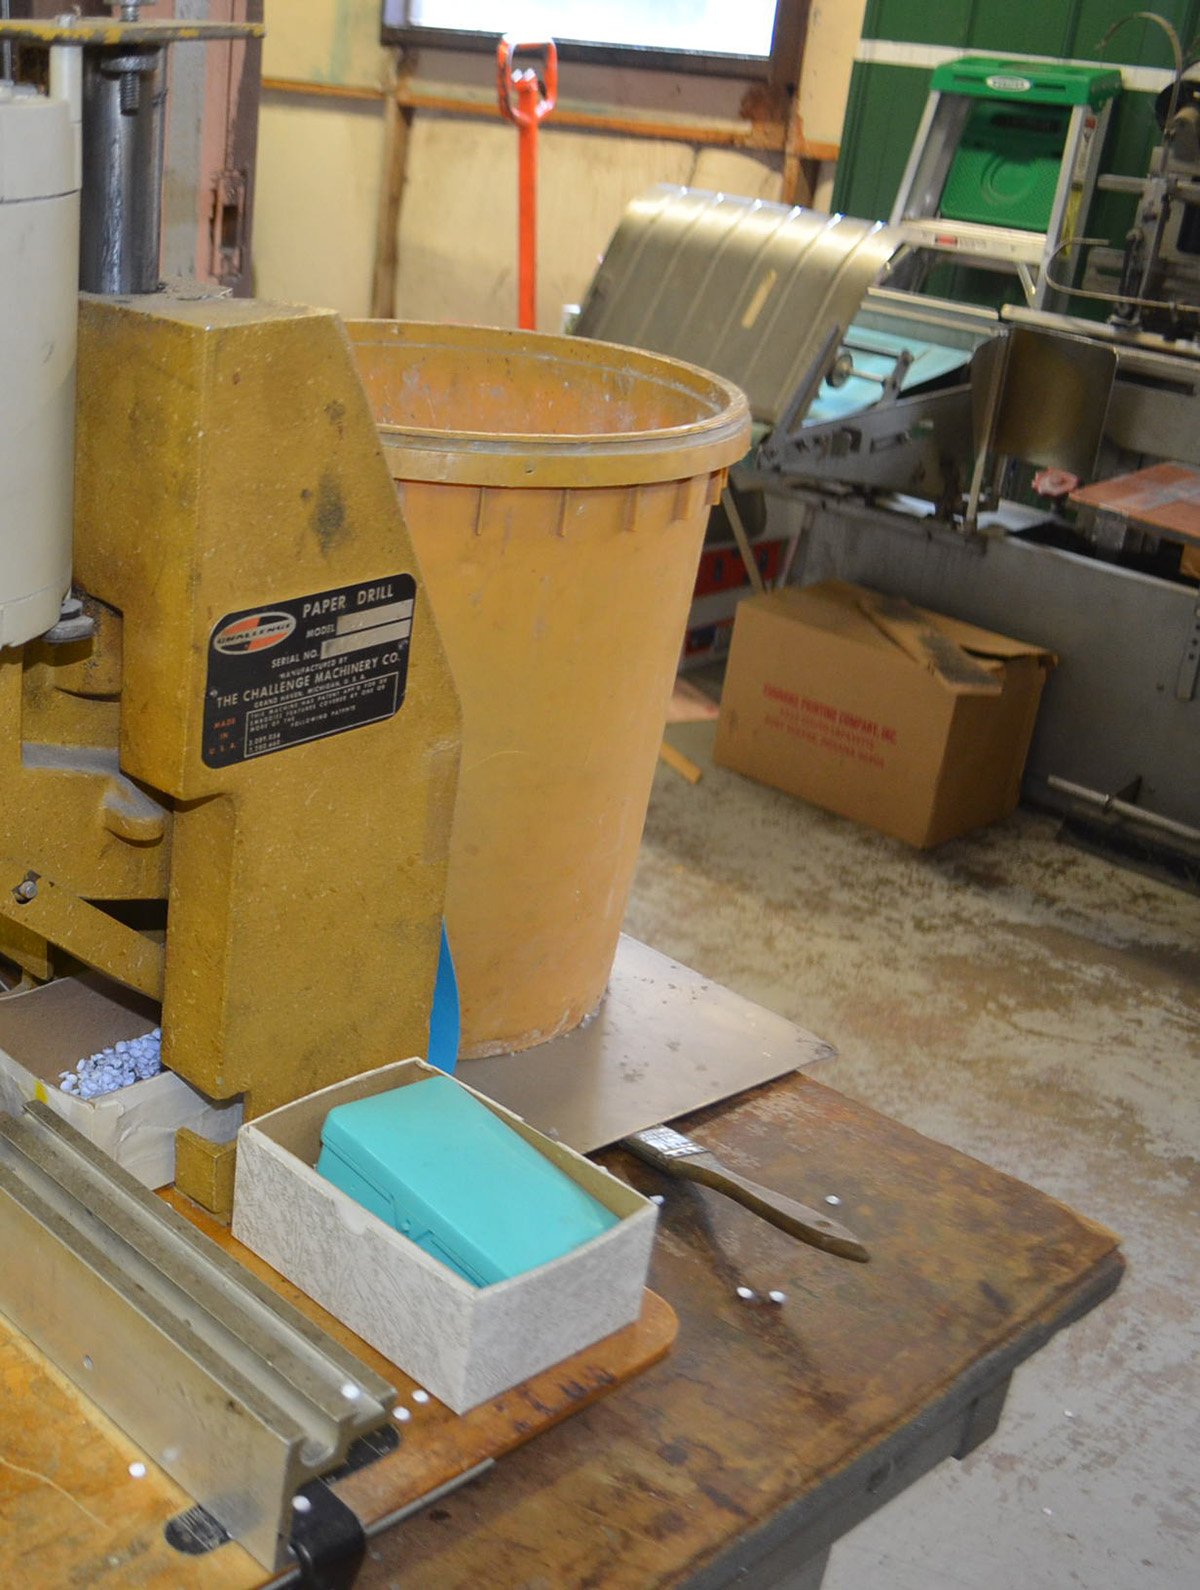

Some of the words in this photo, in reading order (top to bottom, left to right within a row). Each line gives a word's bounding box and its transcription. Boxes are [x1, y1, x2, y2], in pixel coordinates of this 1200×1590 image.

[302, 595, 346, 618] PAPER
[357, 584, 394, 606] DRILL
[305, 624, 335, 638] MODEL
[271, 654, 300, 669] SERIAL
[303, 649, 319, 660] NO.
[279, 661, 337, 679] MANUFACTURED
[339, 656, 348, 665] BY
[217, 693, 238, 709] THE
[243, 675, 310, 702] CHALLENGE
[314, 657, 379, 684] MACHINERY
[382, 652, 400, 665] CO.
[250, 711, 266, 720] THIS
[268, 703, 299, 717] MACHINE
[301, 697, 315, 706] HAS
[317, 691, 341, 703] PATENT
[363, 681, 376, 690] FOR
[250, 714, 282, 727] EMBODIES
[286, 705, 316, 718] FEATURES
[319, 697, 348, 709] COVERED
[361, 687, 374, 697] ONE
[253, 697, 278, 709] GRAND
[213, 717, 236, 729] MADE
[250, 723, 268, 732] MORE
[283, 716, 295, 725] THE
[290, 712, 328, 728] FOLLOWING
[220, 731, 229, 740] IN
